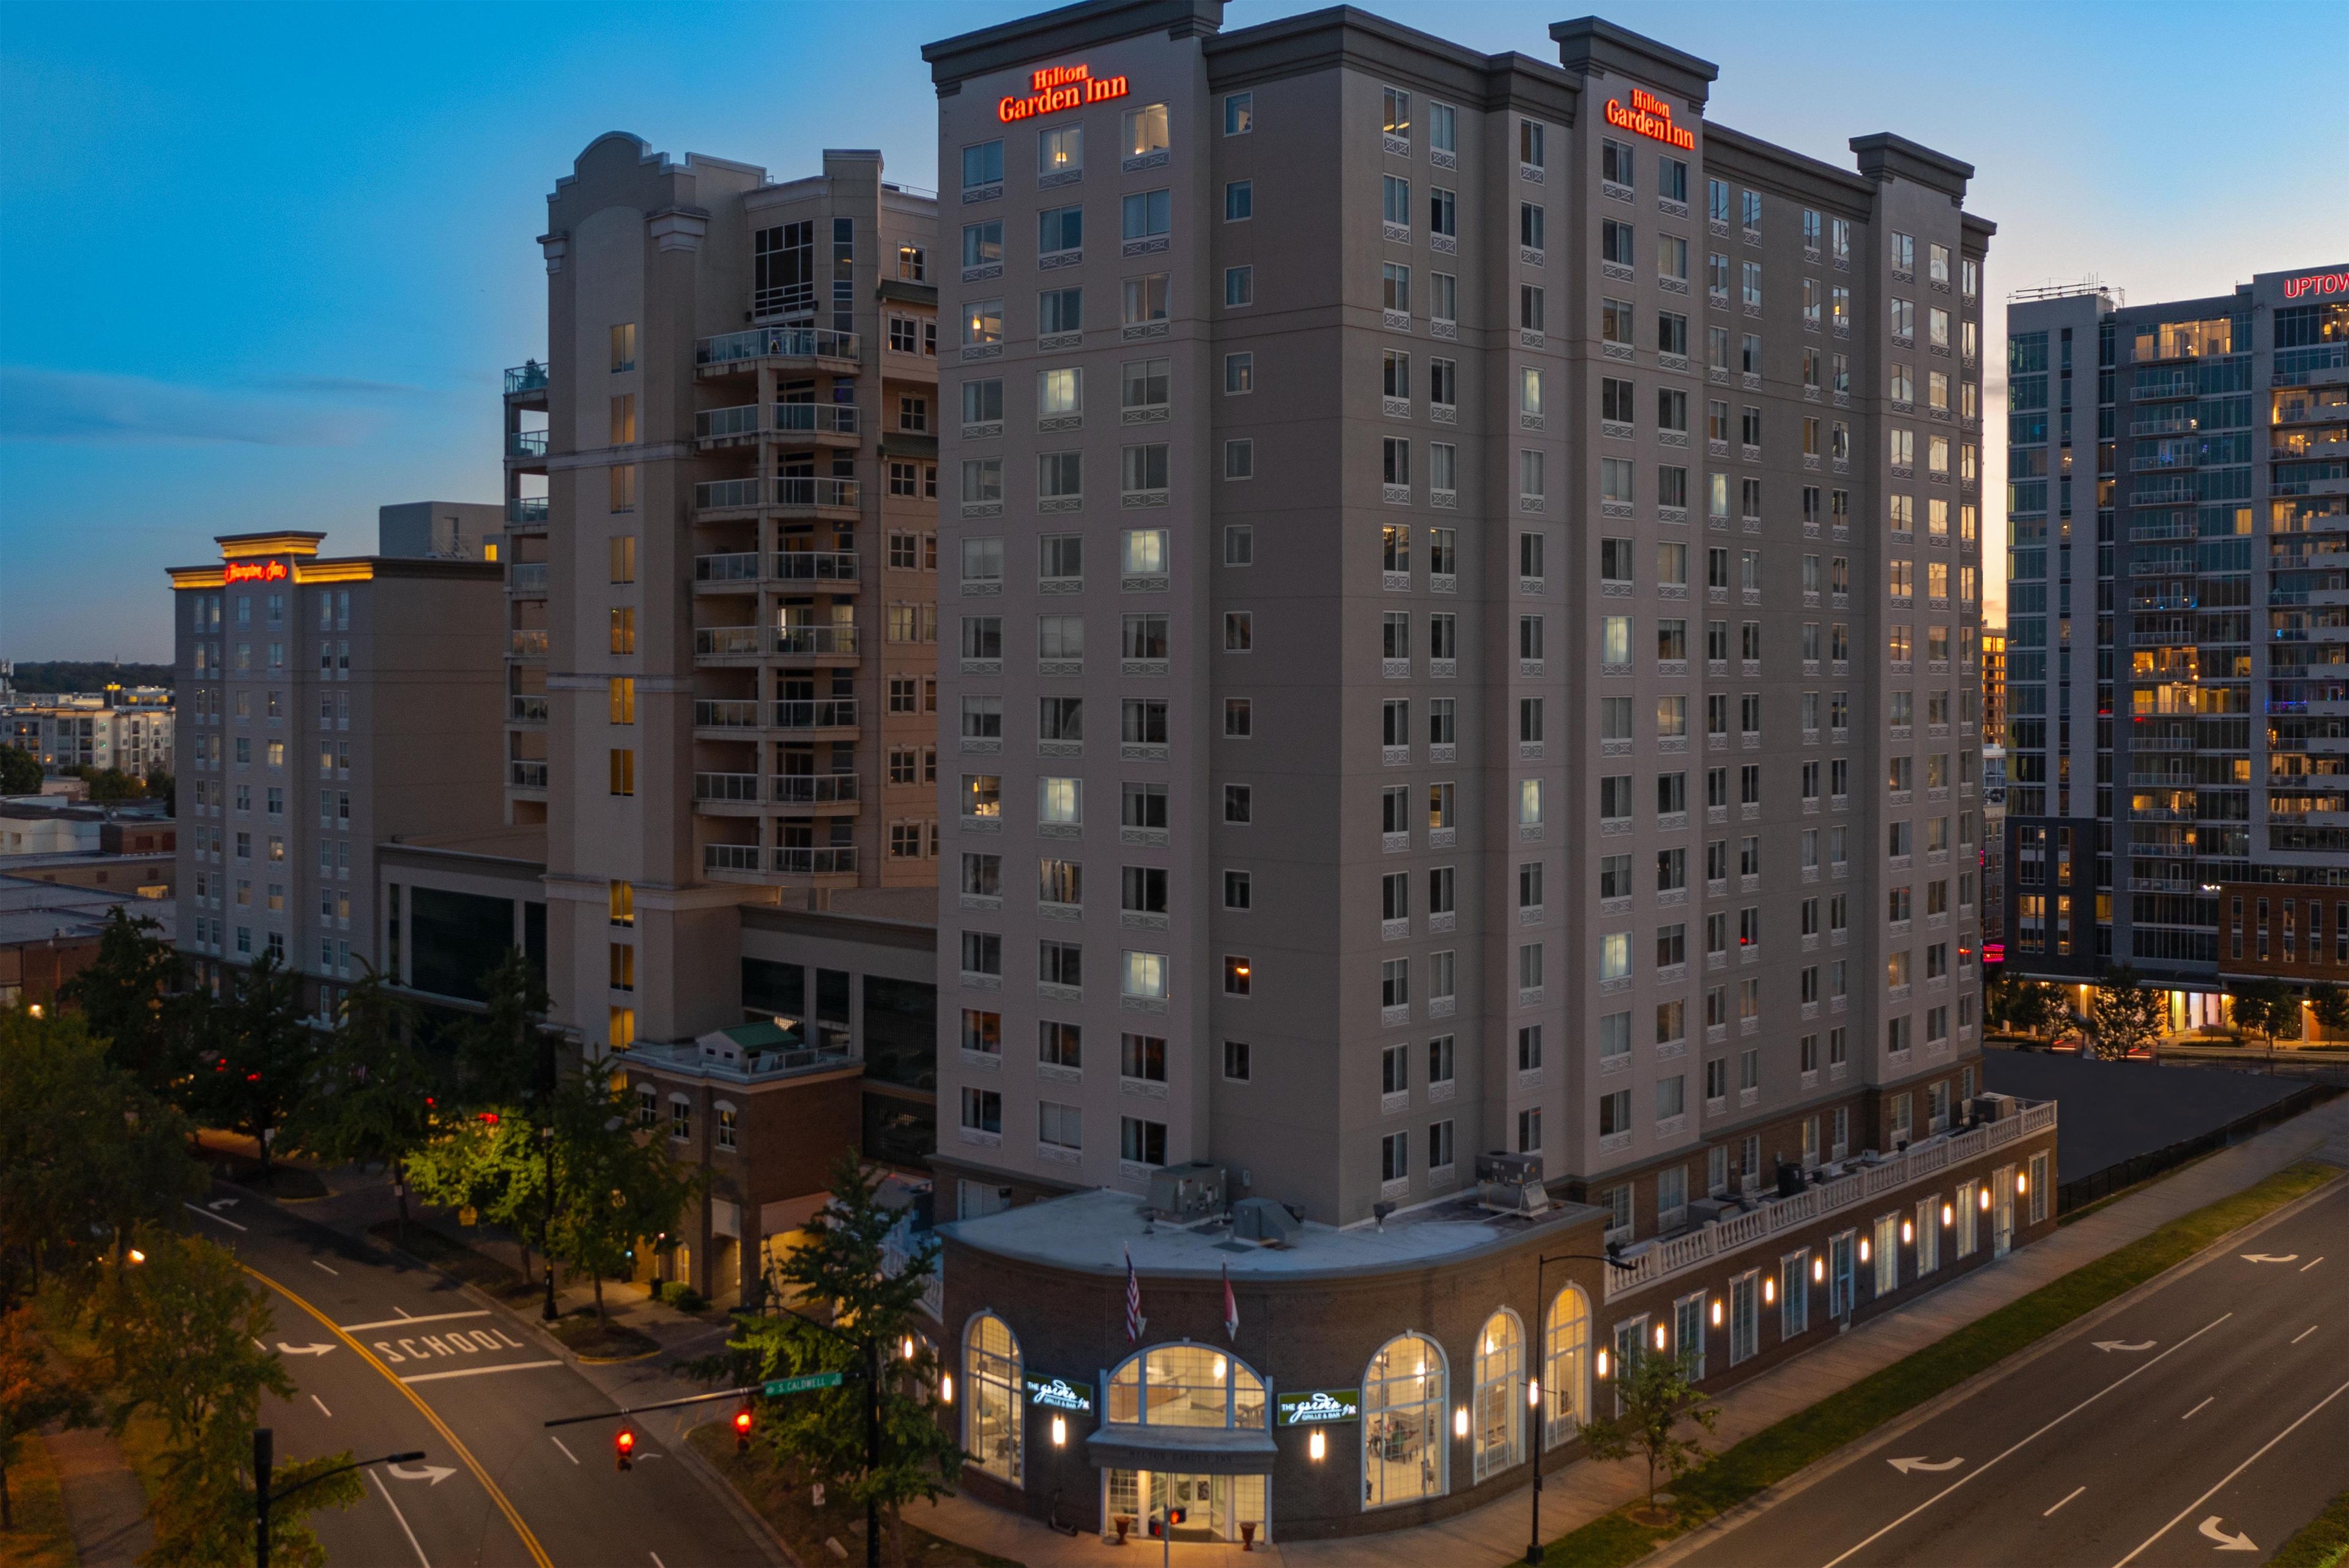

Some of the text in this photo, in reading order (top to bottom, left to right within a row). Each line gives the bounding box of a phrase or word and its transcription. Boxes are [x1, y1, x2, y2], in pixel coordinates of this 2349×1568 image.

[1033, 64, 1089, 91] Hilton
[999, 75, 1129, 122] Garden Inn
[1632, 88, 1670, 118] Hilton
[1606, 98, 1694, 150] Garden Inn
[224, 562, 265, 584] Hampton
[374, 1328, 524, 1362] SCHOOL
[787, 1377, 826, 1391] CALDWELL
[1027, 1381, 1039, 1391] THE
[1281, 1403, 1296, 1411] THE
